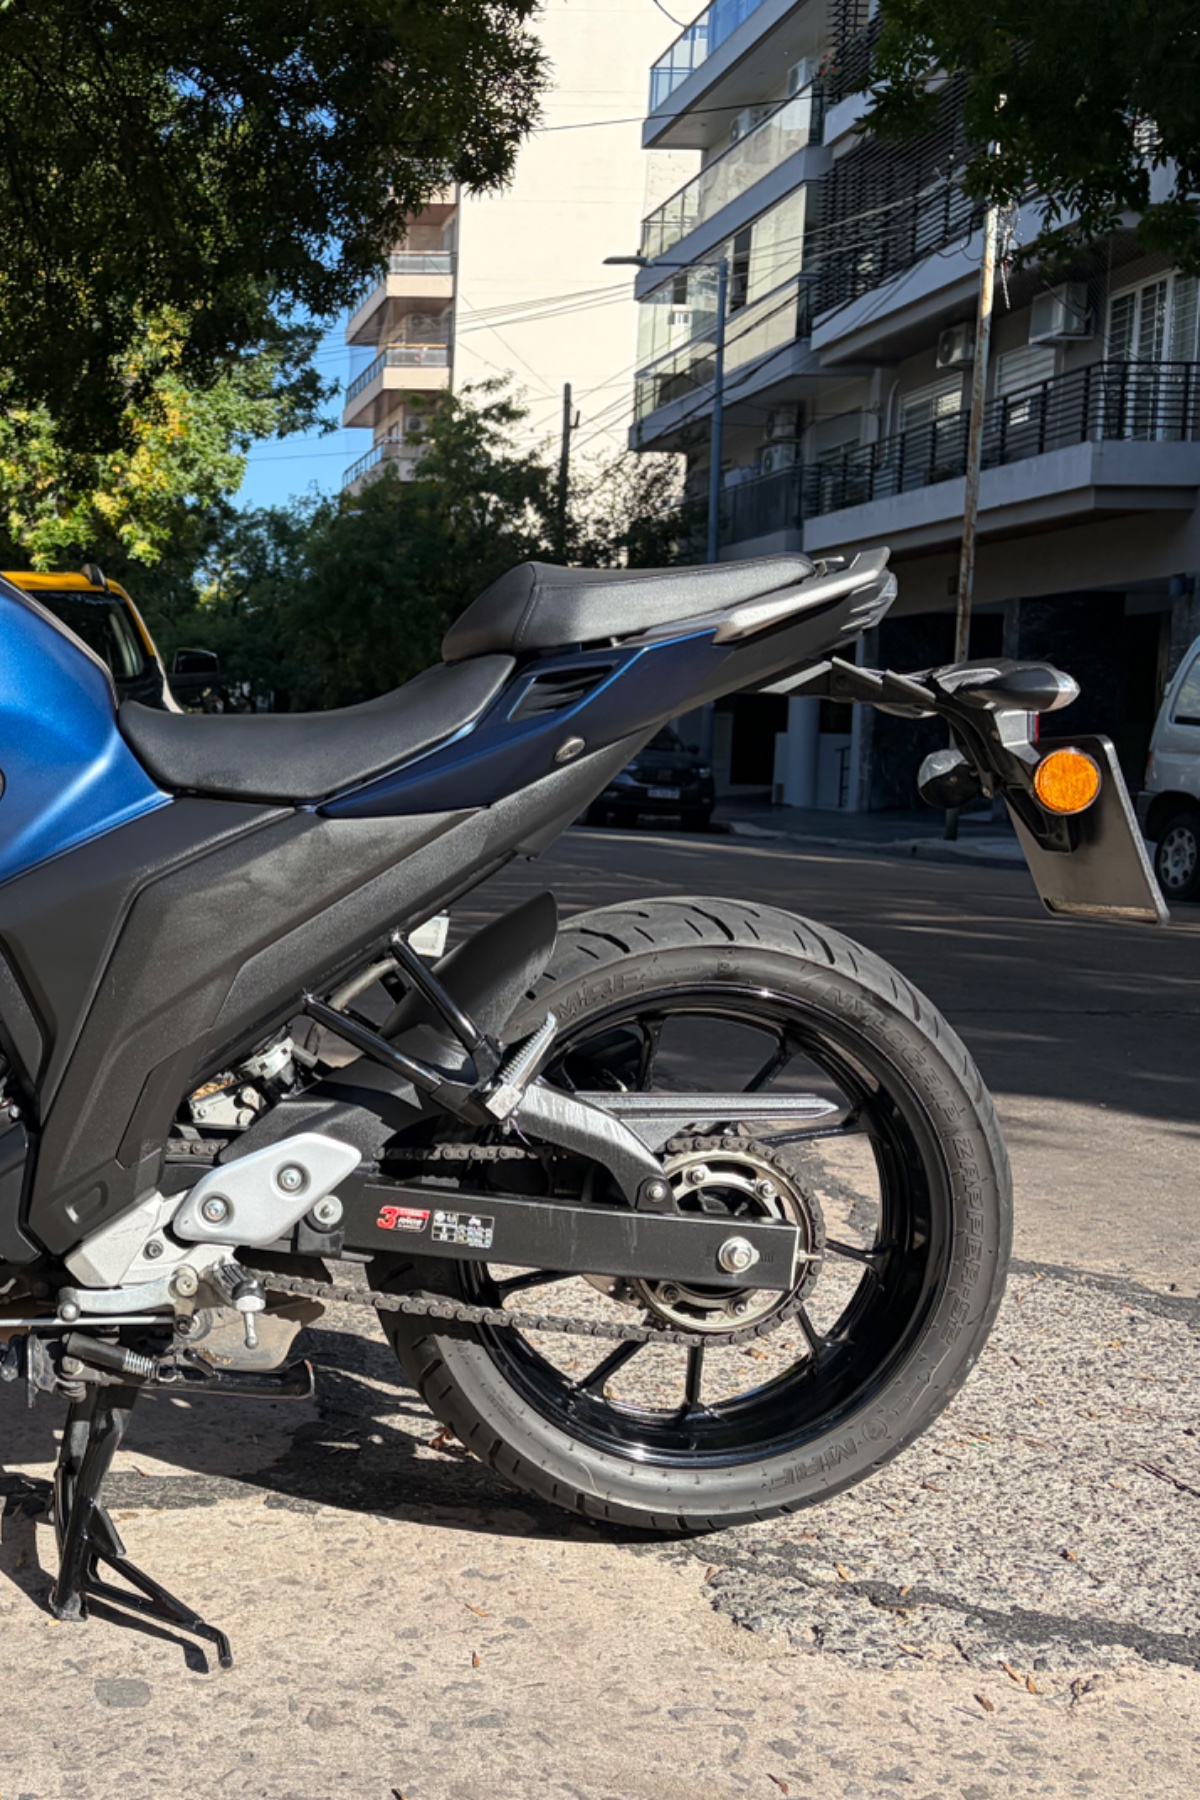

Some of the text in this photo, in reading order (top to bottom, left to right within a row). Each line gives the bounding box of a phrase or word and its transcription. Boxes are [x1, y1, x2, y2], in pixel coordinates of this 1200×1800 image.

[557, 966, 644, 1020] MRF
[377, 1205, 398, 1229] 3
[769, 1437, 858, 1493] MRF
